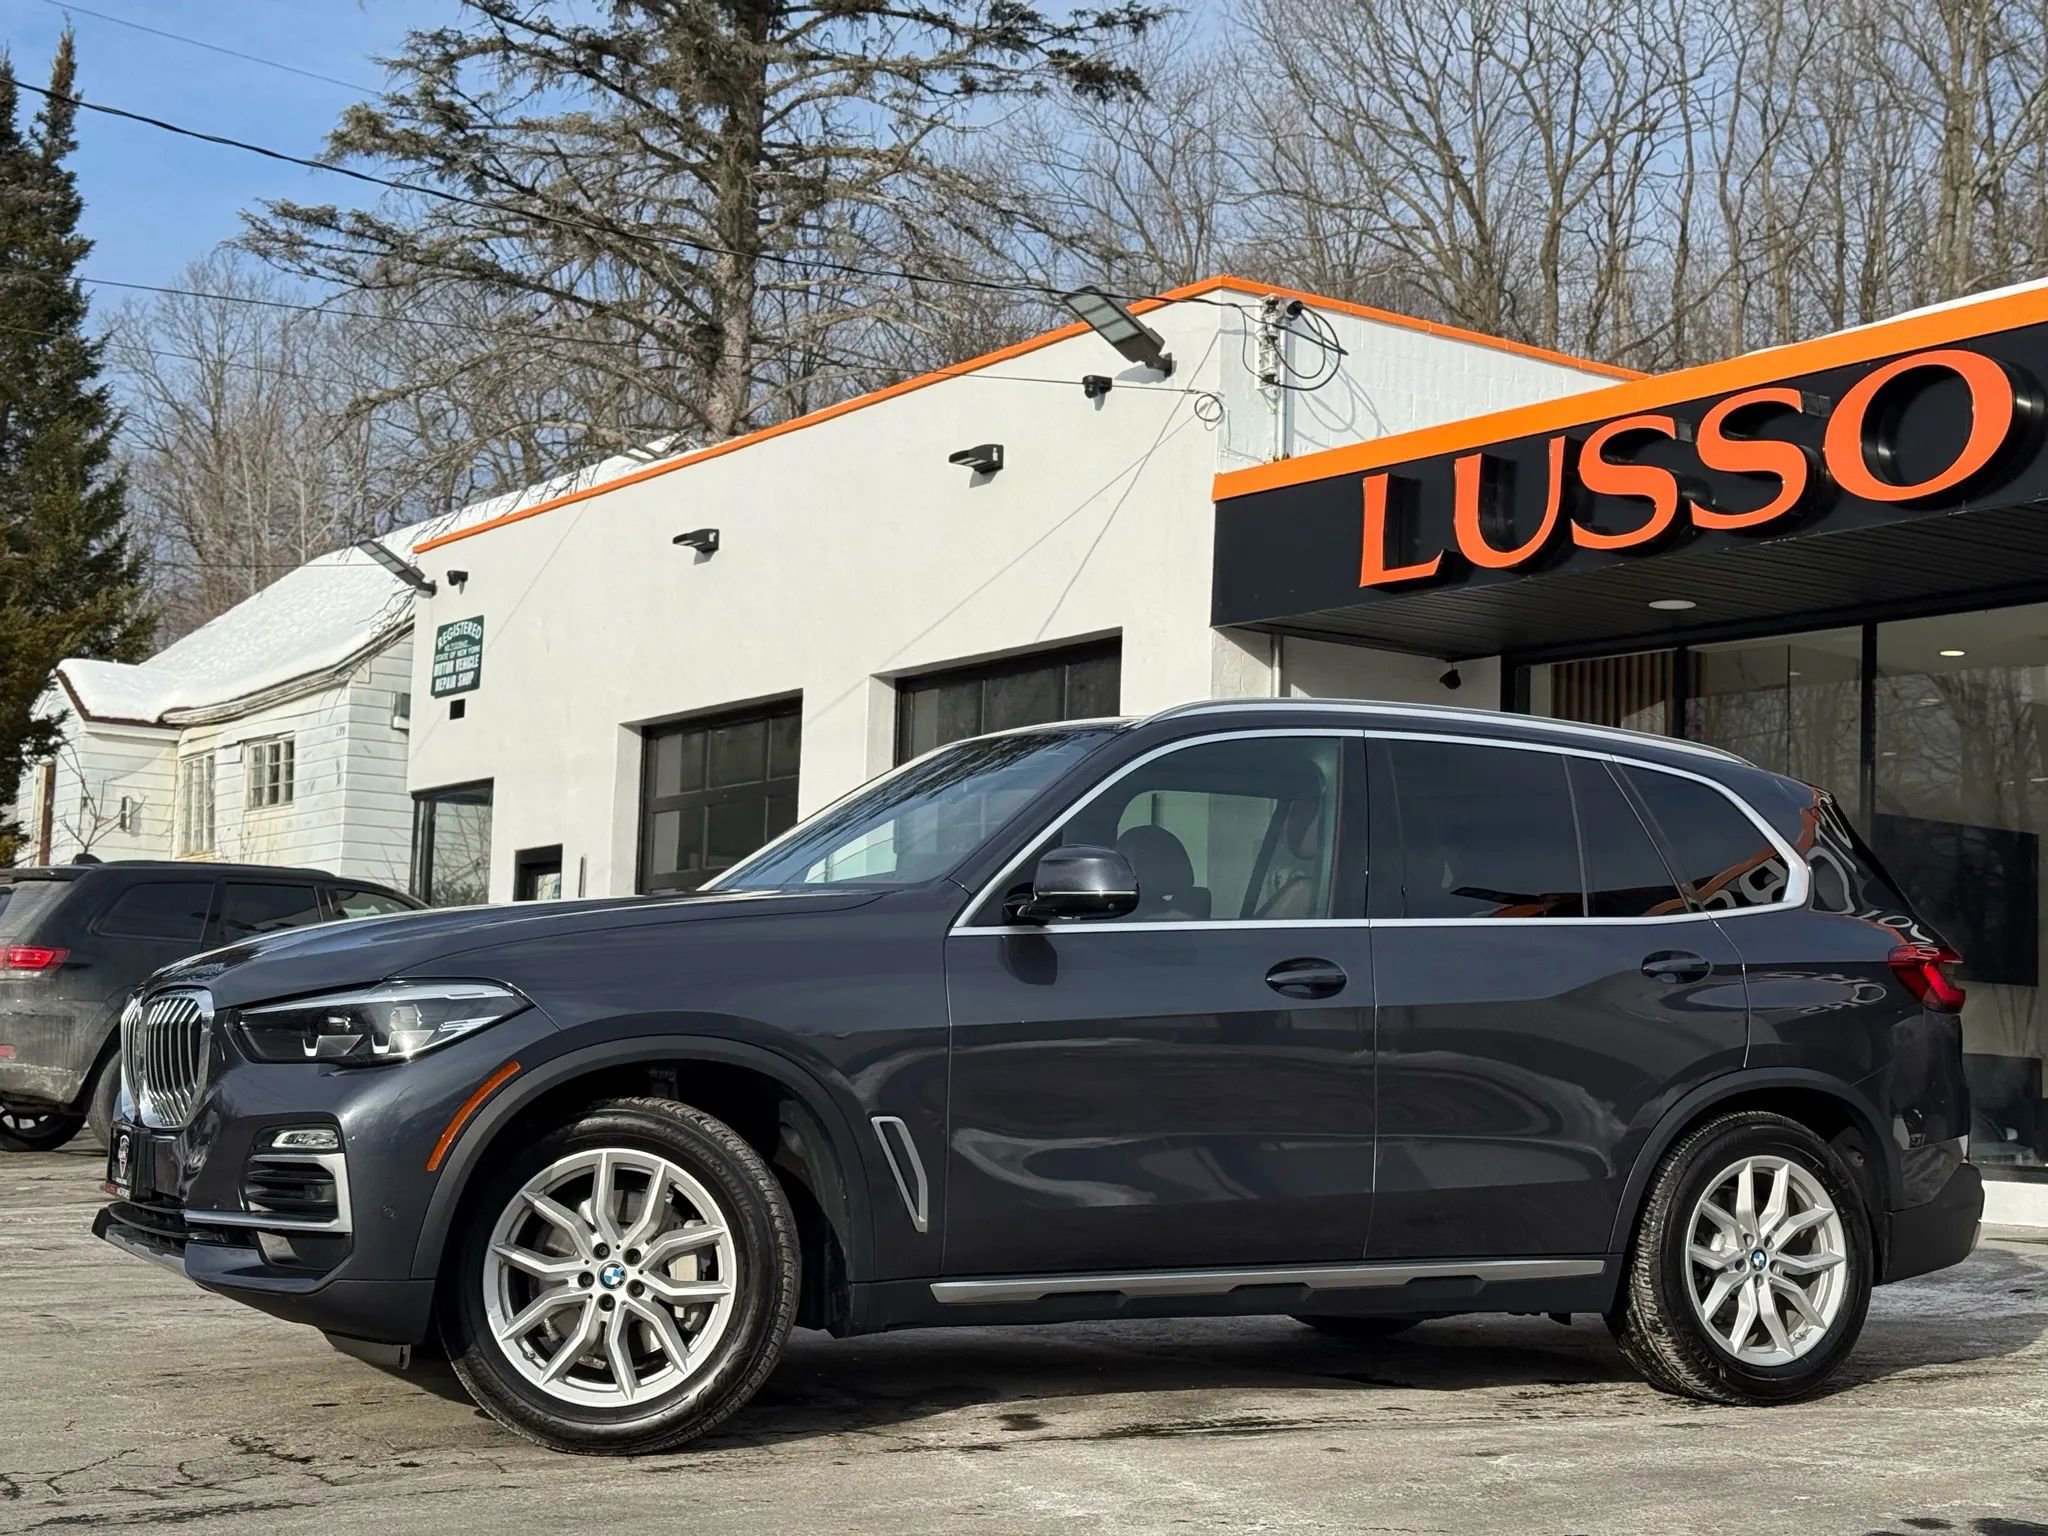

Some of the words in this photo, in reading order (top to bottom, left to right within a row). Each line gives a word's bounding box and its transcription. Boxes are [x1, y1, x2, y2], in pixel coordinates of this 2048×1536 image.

[1359, 349, 2014, 588] LUSSO
[438, 621, 482, 650] REGISTERED
[456, 654, 480, 672] VEHICLE
